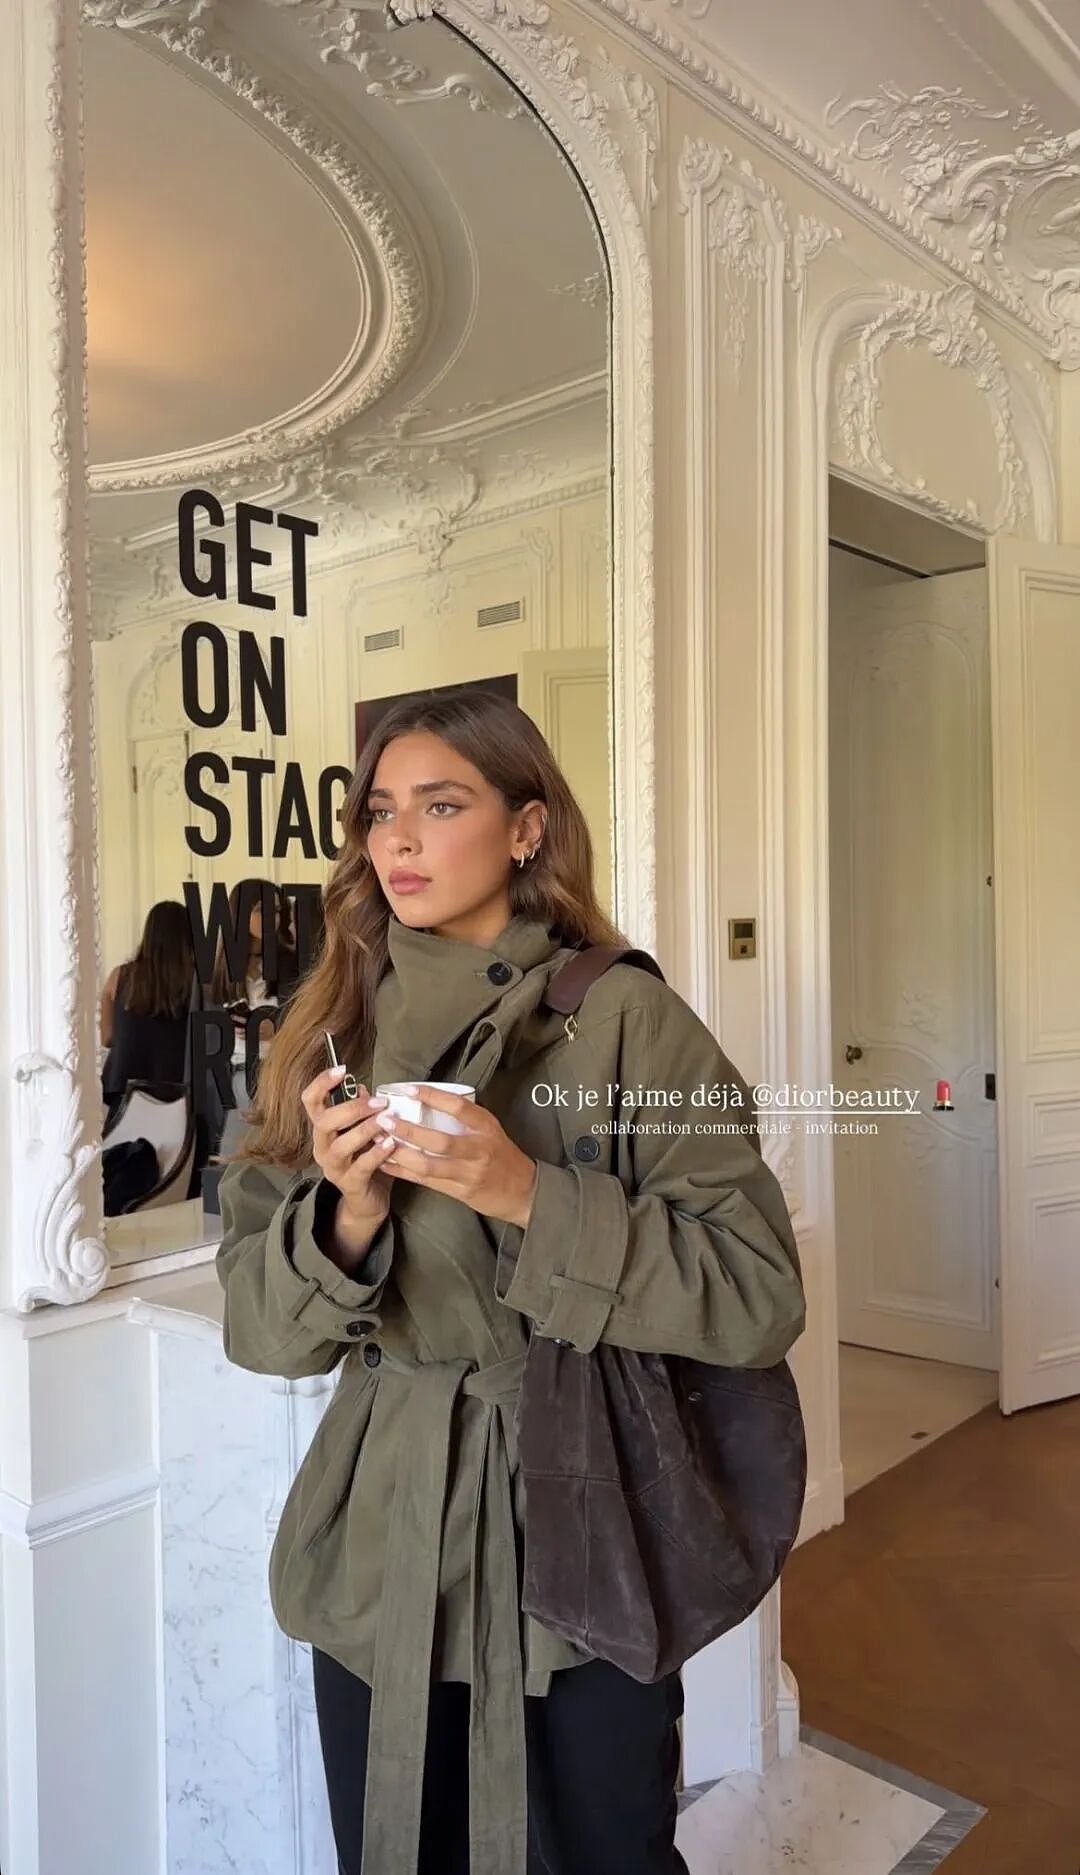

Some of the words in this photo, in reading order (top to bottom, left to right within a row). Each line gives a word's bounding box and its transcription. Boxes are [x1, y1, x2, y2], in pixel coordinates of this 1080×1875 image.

[178, 489, 319, 617] GET
[181, 621, 287, 736] ON
[184, 751, 352, 861] STAG
[182, 882, 323, 985] WIT
[191, 1005, 279, 1112] RO
